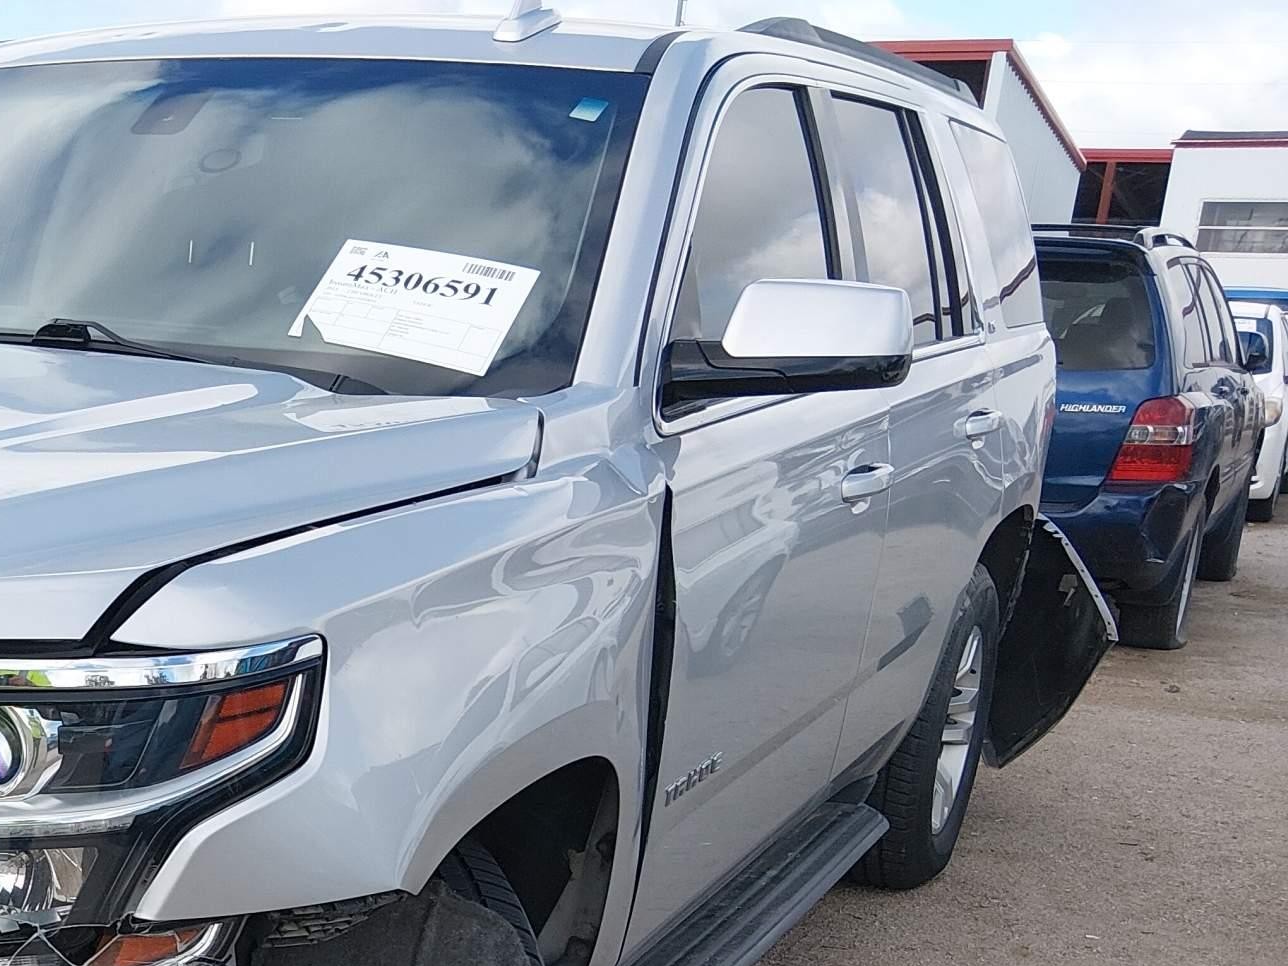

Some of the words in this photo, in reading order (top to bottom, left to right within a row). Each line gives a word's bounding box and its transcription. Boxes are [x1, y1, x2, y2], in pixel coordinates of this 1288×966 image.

[345, 264, 500, 307] 45306591
[1060, 403, 1127, 413] HIGHLANDER
[664, 751, 722, 808] TAHOE
